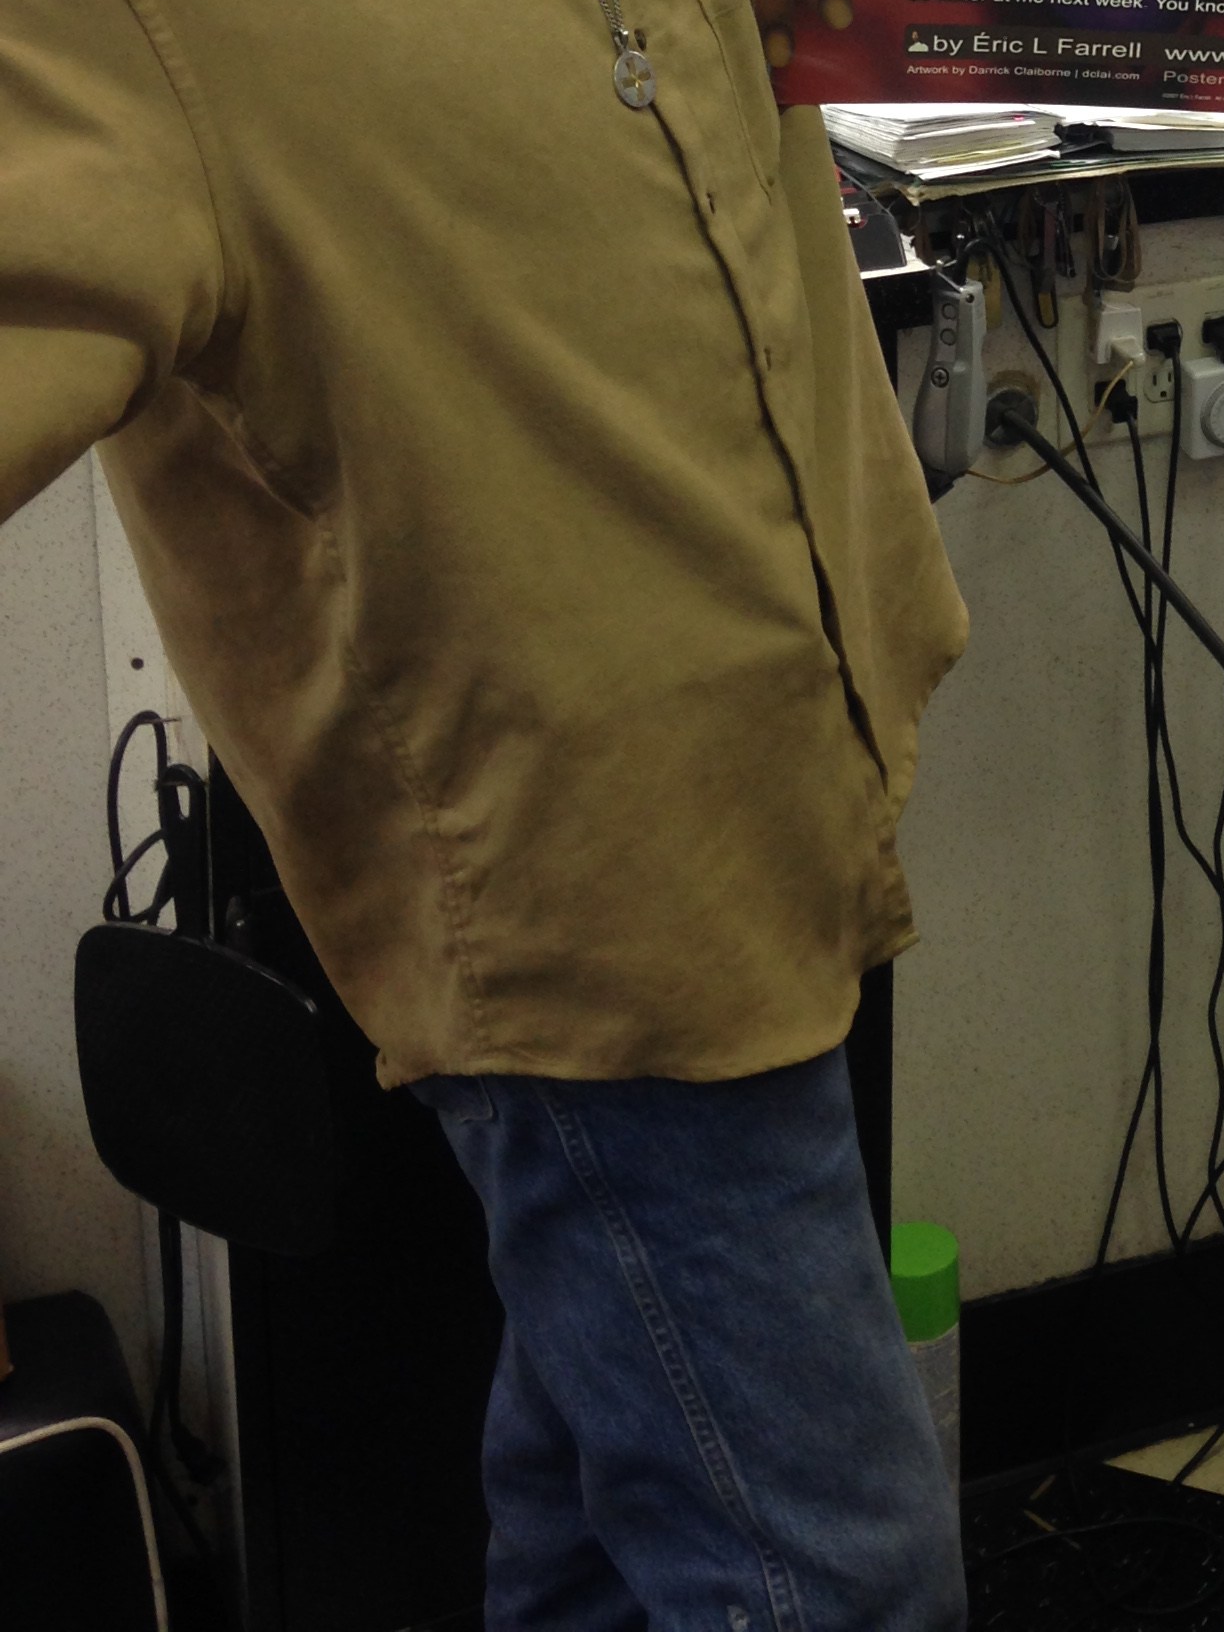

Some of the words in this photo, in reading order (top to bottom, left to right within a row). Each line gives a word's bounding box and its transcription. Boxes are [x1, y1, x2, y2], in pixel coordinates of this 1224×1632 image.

[932, 35, 964, 56] by
[972, 30, 1024, 55] Éric
[1033, 37, 1048, 55] L
[1057, 38, 1143, 60] Farrell
[906, 64, 949, 76] Artwork
[952, 65, 966, 76] by
[969, 65, 1010, 77] Darrick
[1014, 66, 1072, 78] Claiborne
